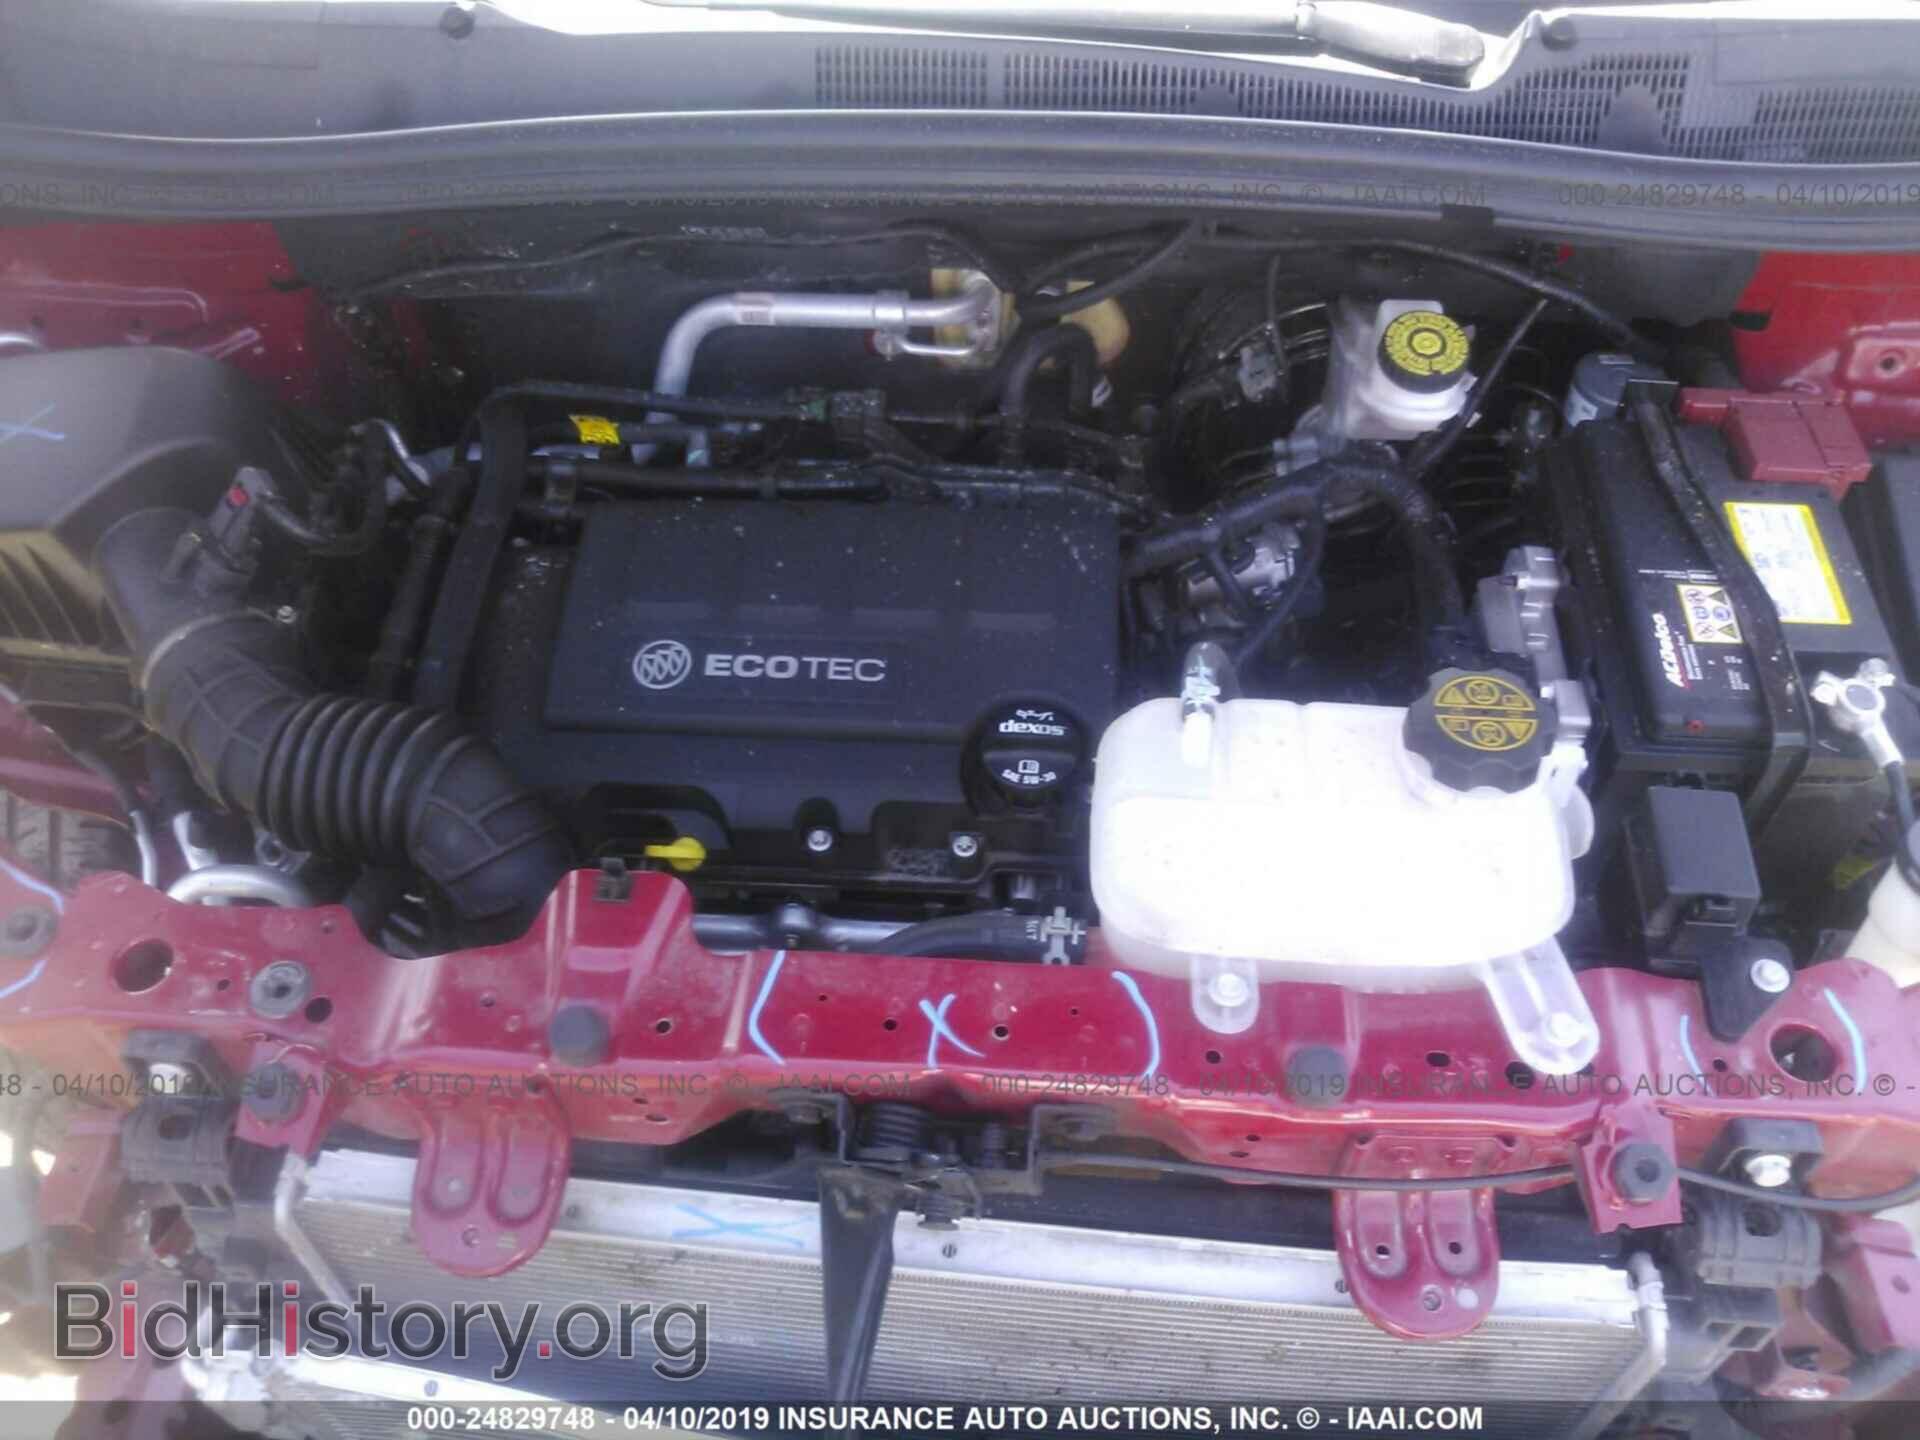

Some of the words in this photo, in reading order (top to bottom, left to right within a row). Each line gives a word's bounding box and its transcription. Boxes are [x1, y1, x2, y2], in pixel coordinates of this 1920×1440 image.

[1651, 612, 1685, 688] ACDelco
[704, 654, 886, 682] ECOTEC
[999, 719, 1065, 736] dexos
